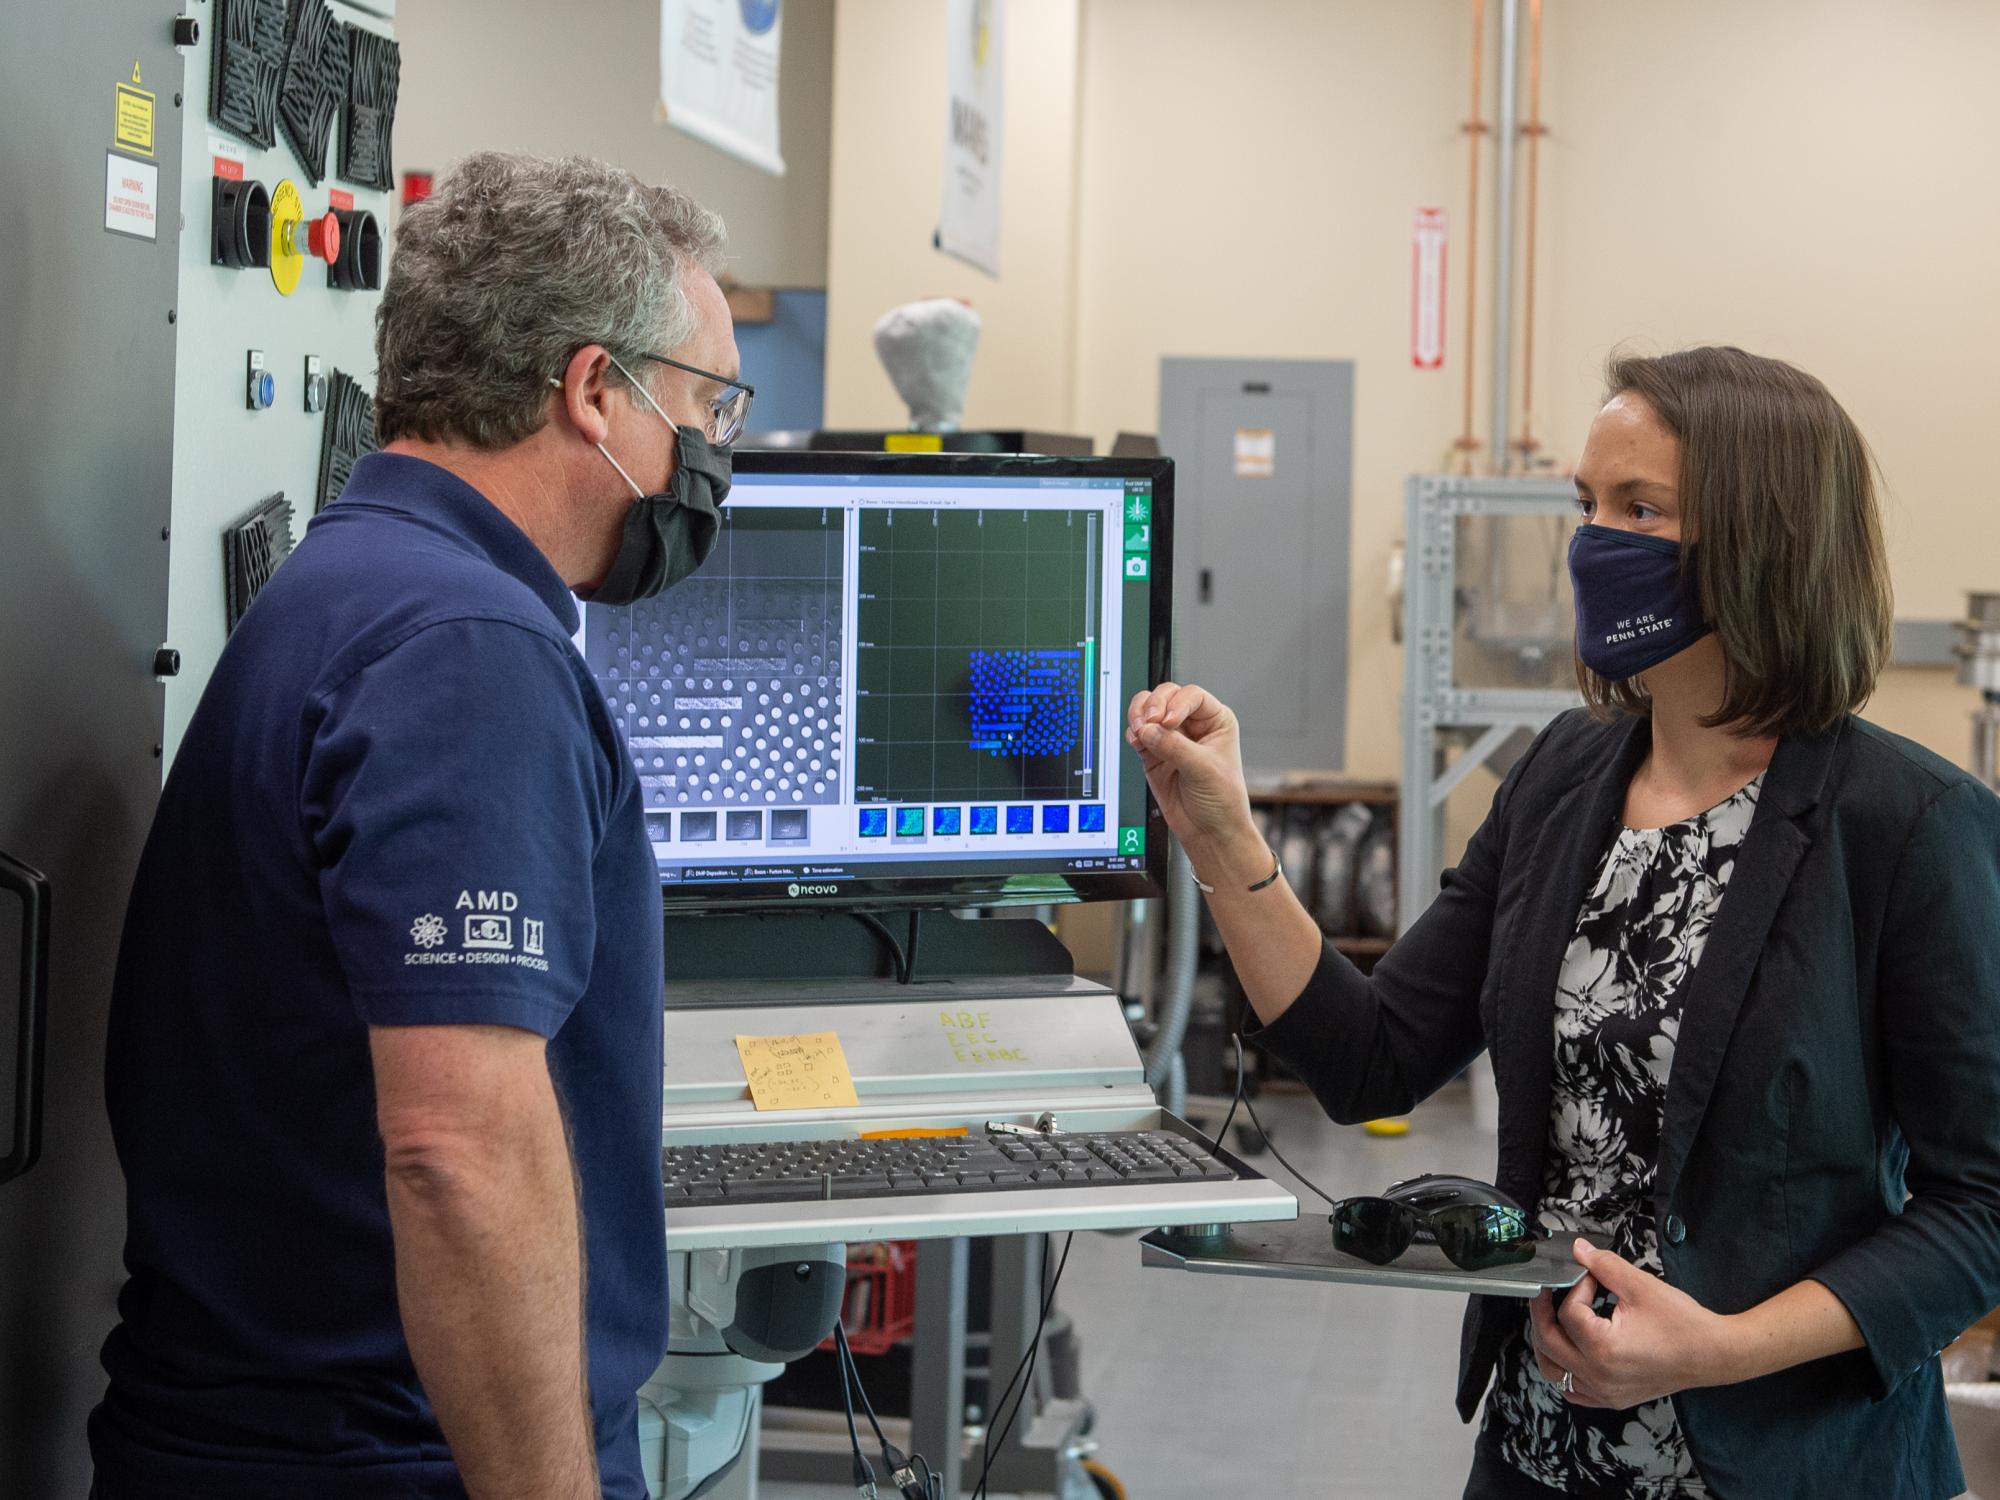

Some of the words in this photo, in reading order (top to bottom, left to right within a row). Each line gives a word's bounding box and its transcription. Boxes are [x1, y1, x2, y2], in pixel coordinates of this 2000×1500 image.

[121, 177, 144, 193] WARNING
[1616, 619, 1632, 630] WE
[1636, 613, 1656, 625] ARE
[1606, 630, 1636, 645] PENN
[800, 884, 838, 895] neovo
[455, 890, 518, 912] AMD
[404, 952, 457, 965] SCIENCE
[465, 952, 510, 965] DESIGN
